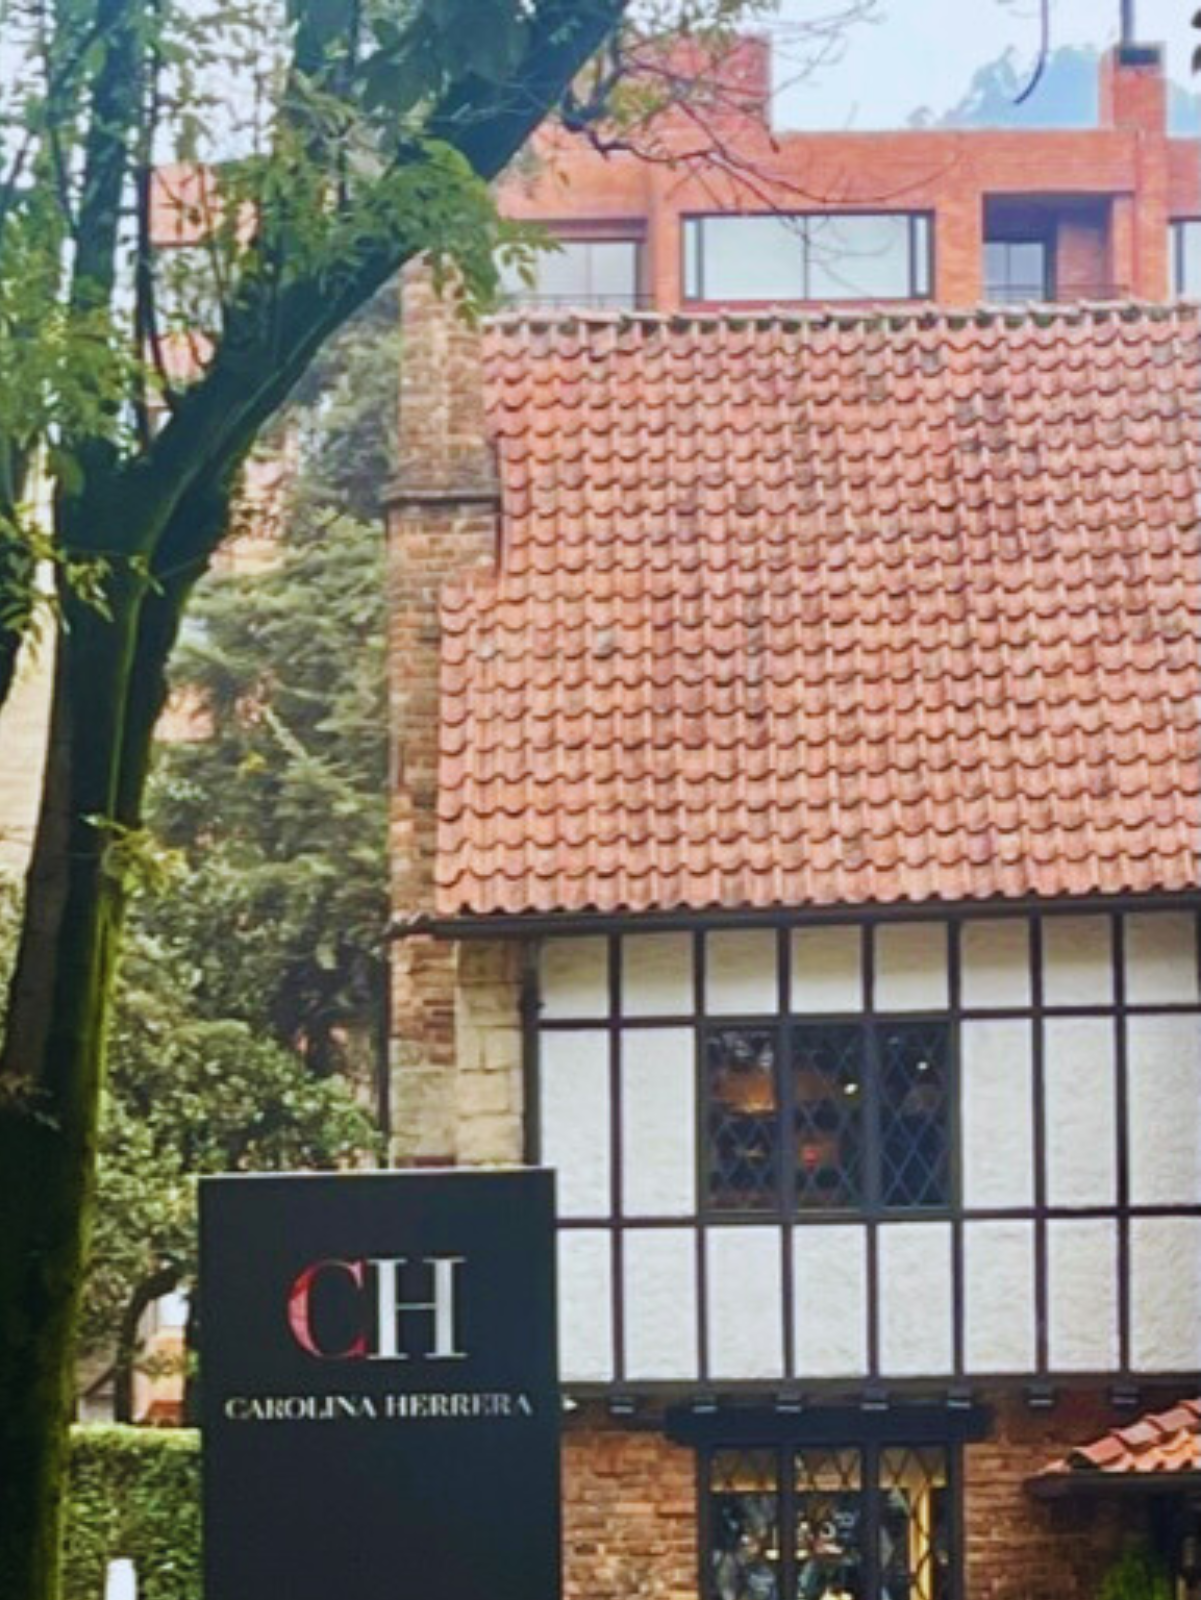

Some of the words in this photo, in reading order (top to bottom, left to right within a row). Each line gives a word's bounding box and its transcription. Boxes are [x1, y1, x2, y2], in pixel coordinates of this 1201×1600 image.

[286, 1256, 468, 1361] CH
[224, 1396, 378, 1420] CAROLINA
[385, 1393, 533, 1418] HERRERA
